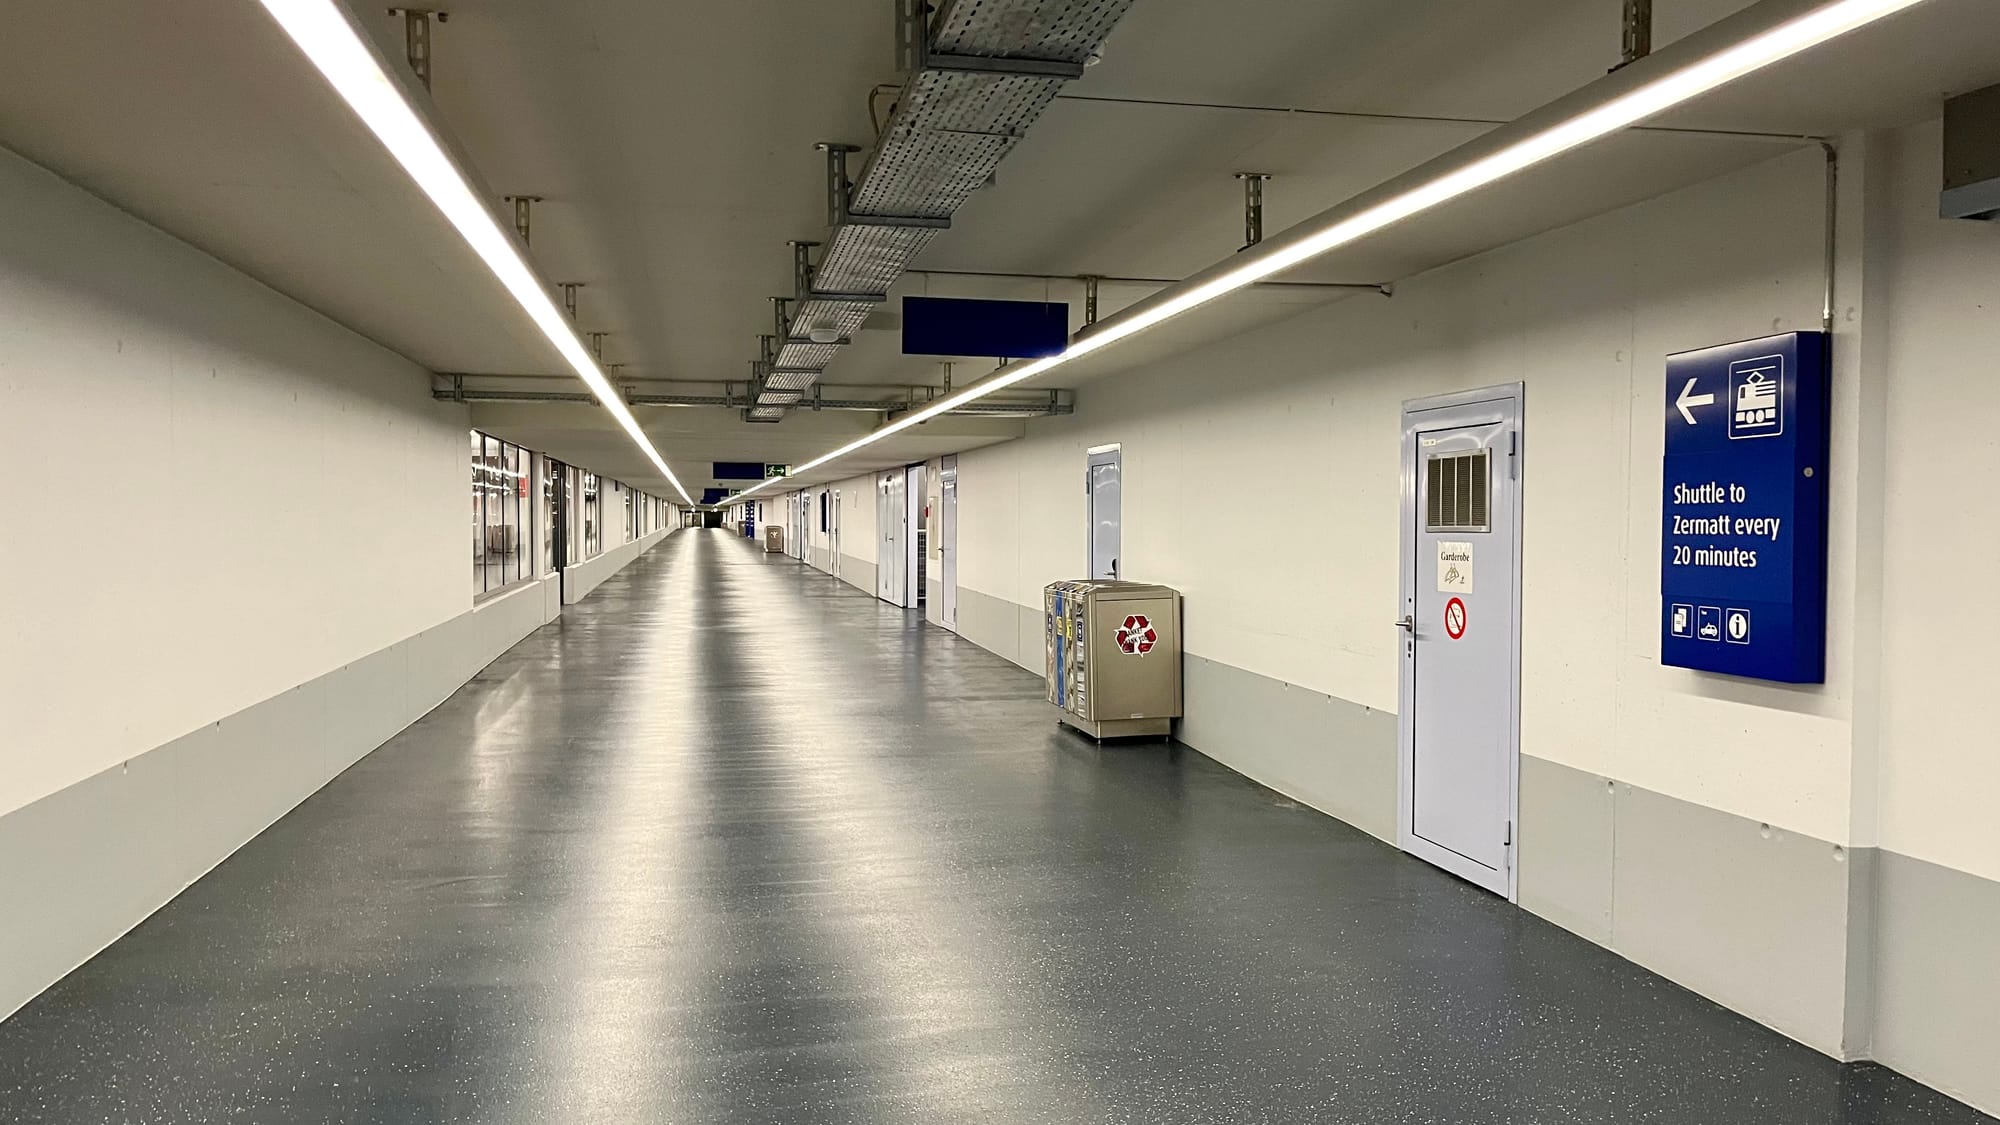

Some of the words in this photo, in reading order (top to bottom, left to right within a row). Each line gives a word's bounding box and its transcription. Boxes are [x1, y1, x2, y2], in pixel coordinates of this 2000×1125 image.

[1673, 481, 1725, 504] Shuttle
[1730, 483, 1746, 503] to
[1673, 515, 1730, 535] Zermatt
[1735, 518, 1780, 541] every
[1440, 551, 1470, 562] Garderobe
[1673, 545, 1691, 565] 20
[1695, 544, 1757, 568] minutes
